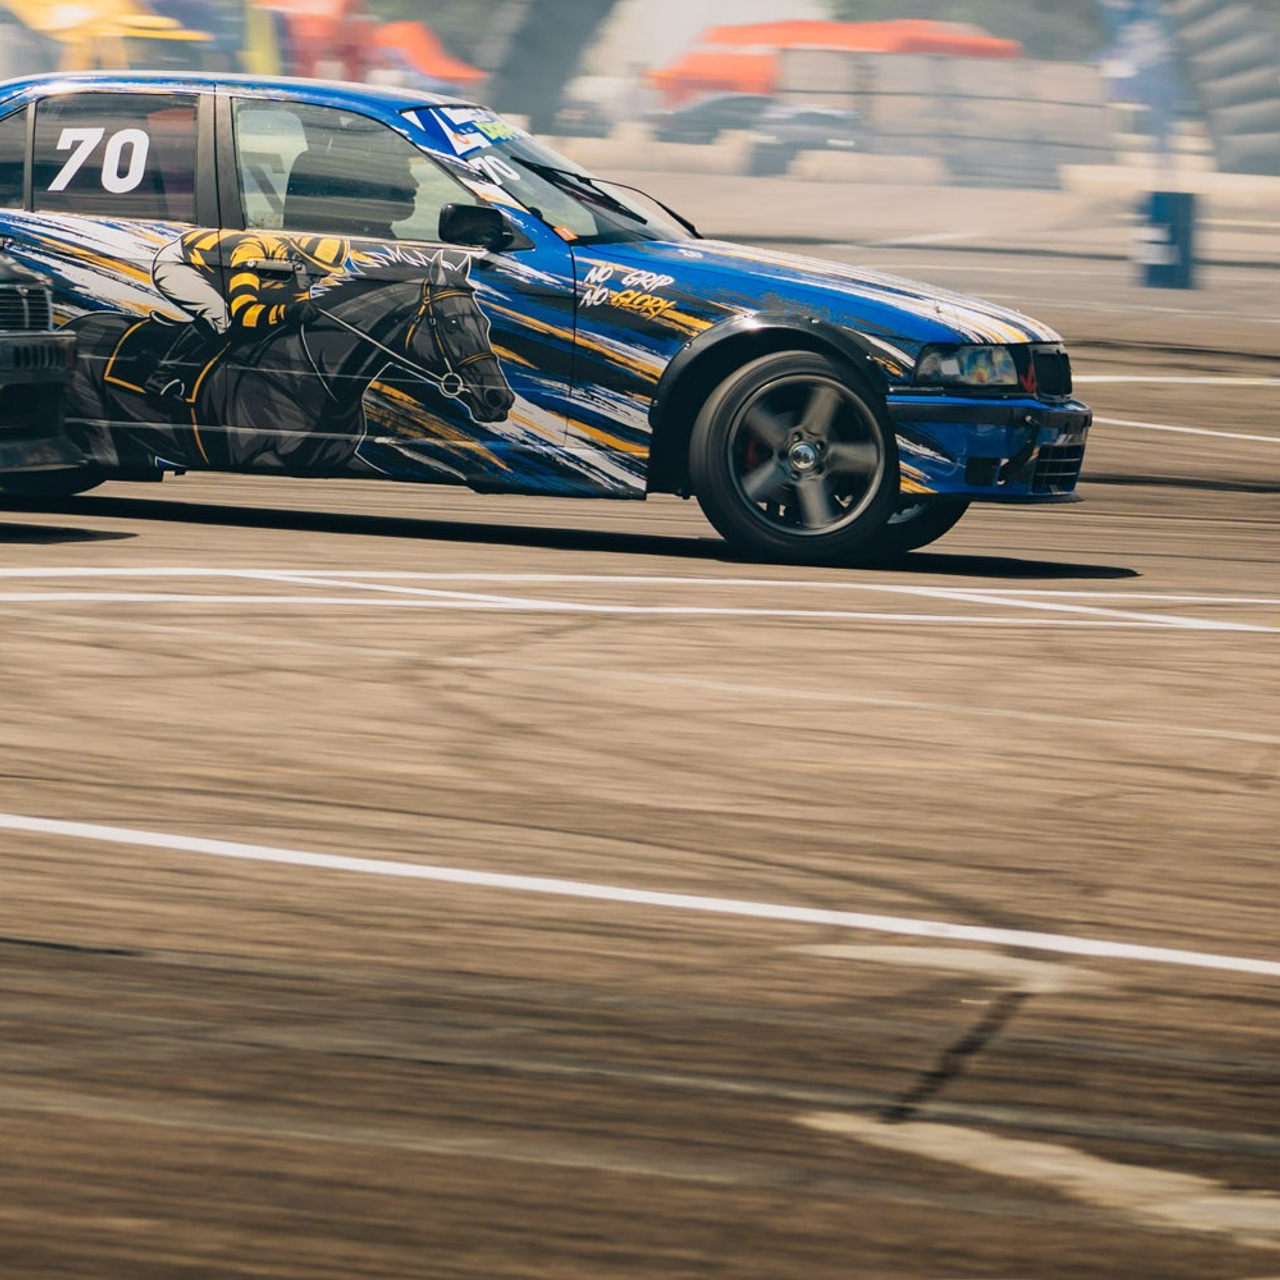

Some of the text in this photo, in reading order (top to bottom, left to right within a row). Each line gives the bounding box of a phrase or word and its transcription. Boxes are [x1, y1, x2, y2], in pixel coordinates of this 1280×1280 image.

[47, 128, 150, 194] 70
[468, 155, 521, 186] 70
[583, 262, 675, 293] NO GRIP
[578, 282, 677, 321] NO GLORY
